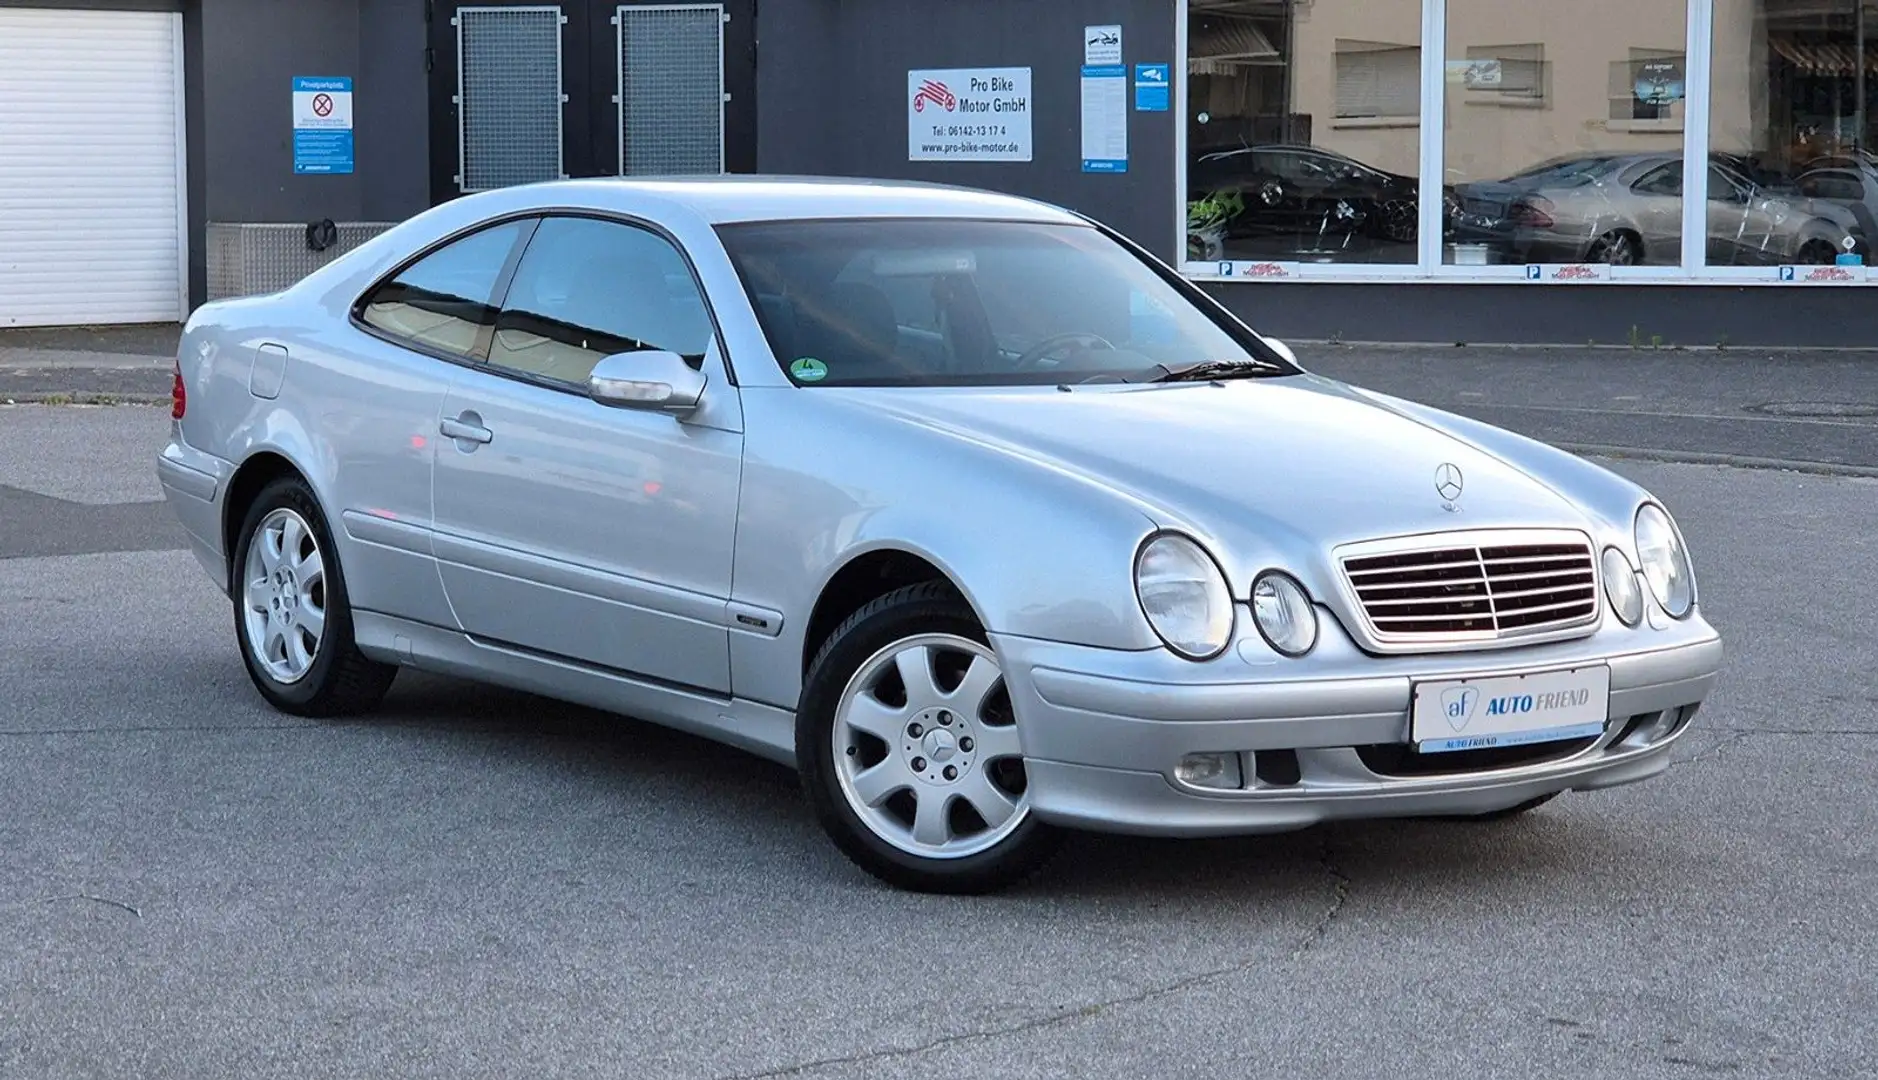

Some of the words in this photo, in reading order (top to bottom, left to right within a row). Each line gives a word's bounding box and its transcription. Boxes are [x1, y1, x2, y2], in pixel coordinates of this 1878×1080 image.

[970, 77, 988, 92] Pro
[991, 76, 1014, 92] Bike
[960, 98, 990, 113] Motor
[993, 97, 1026, 112] GmbH
[932, 126, 946, 137] Tel:
[948, 125, 986, 136] 06142-13
[989, 125, 998, 136] 17
[1000, 125, 1006, 136] 4
[921, 142, 1019, 154] www.pro-bike-motor.de
[803, 359, 814, 370] 4
[1449, 690, 1471, 717] af
[1486, 694, 1533, 716] AUTO
[1535, 687, 1590, 711] FRIEND
[1445, 739, 1467, 749] AUTO
[1467, 737, 1498, 748] FRIEND
